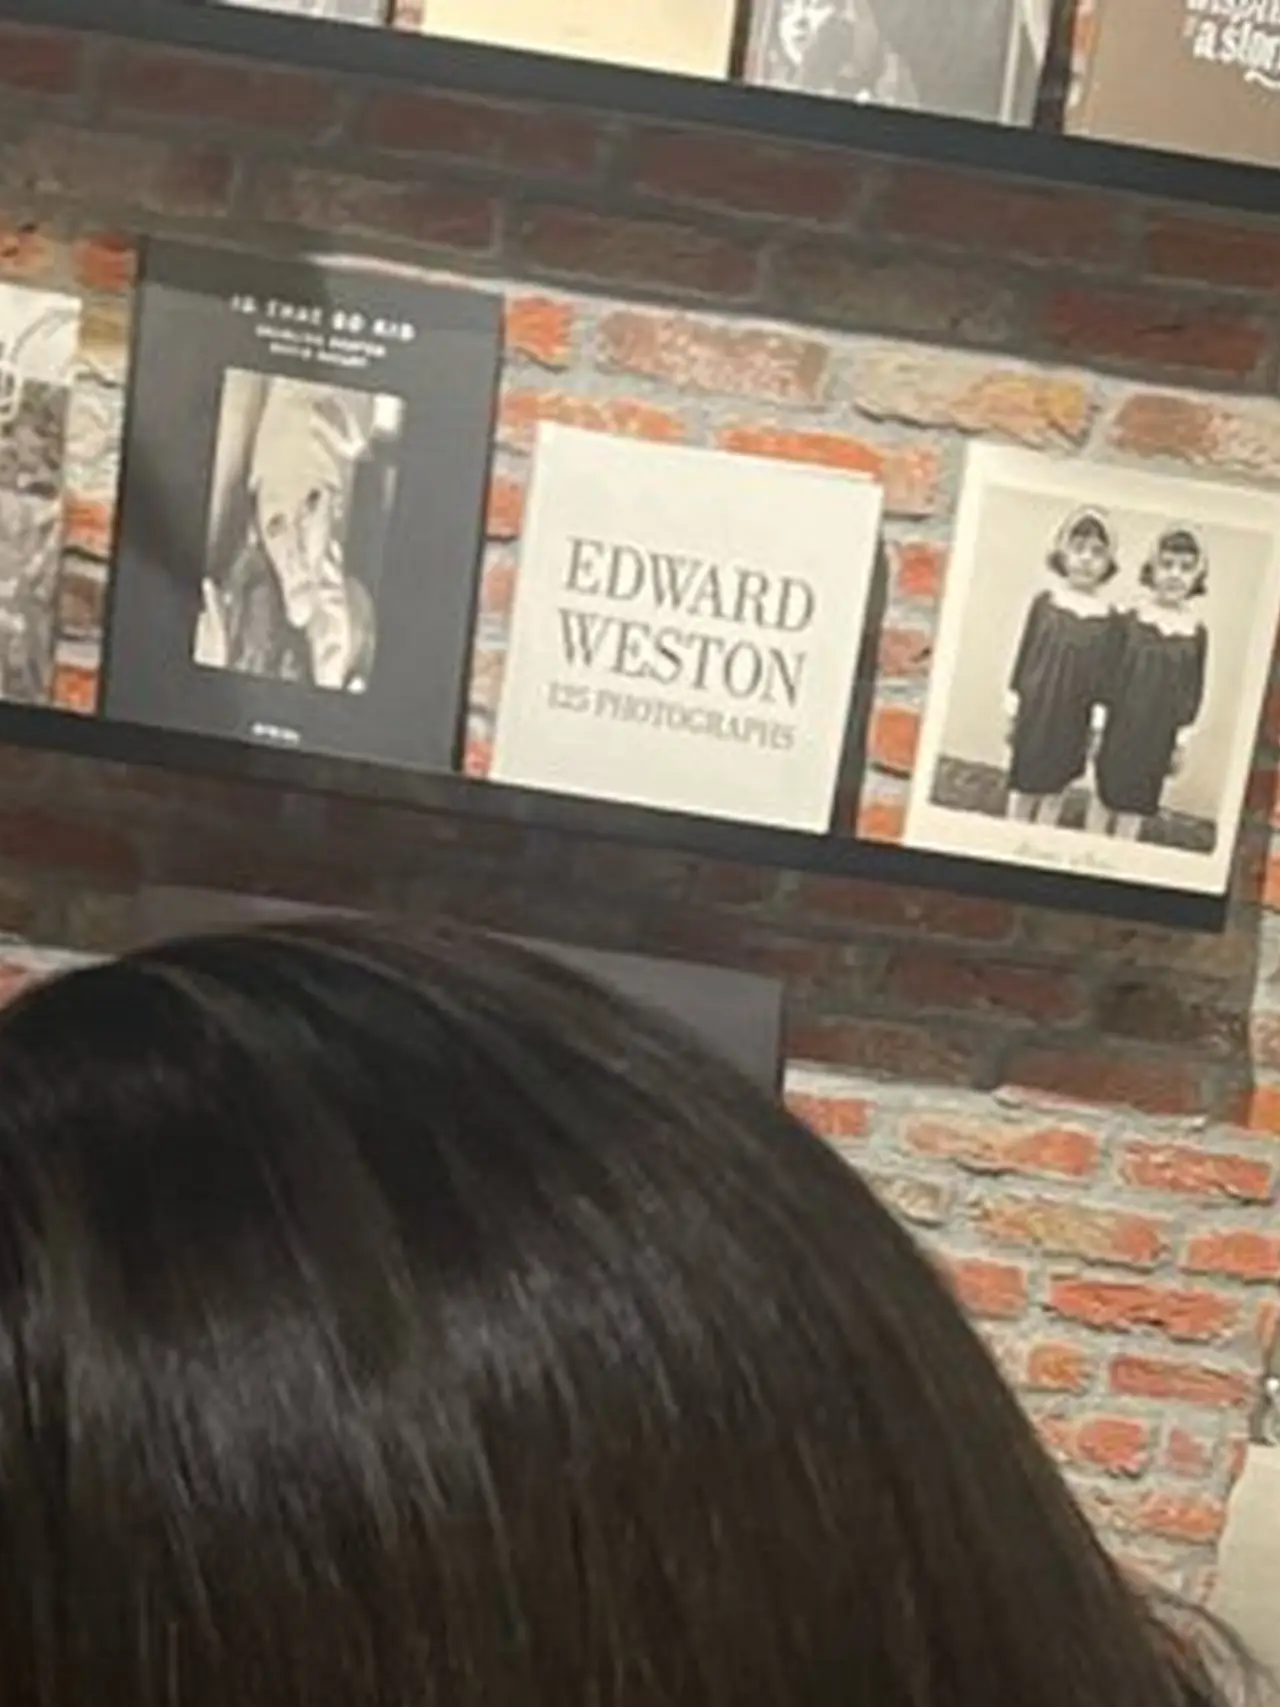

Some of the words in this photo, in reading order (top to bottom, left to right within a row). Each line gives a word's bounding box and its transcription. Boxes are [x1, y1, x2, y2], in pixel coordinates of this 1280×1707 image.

[564, 535, 816, 633] EDWARD
[557, 606, 807, 709] WESTON
[542, 681, 590, 712] 125
[593, 688, 797, 751] PHOTOGRAPHS
